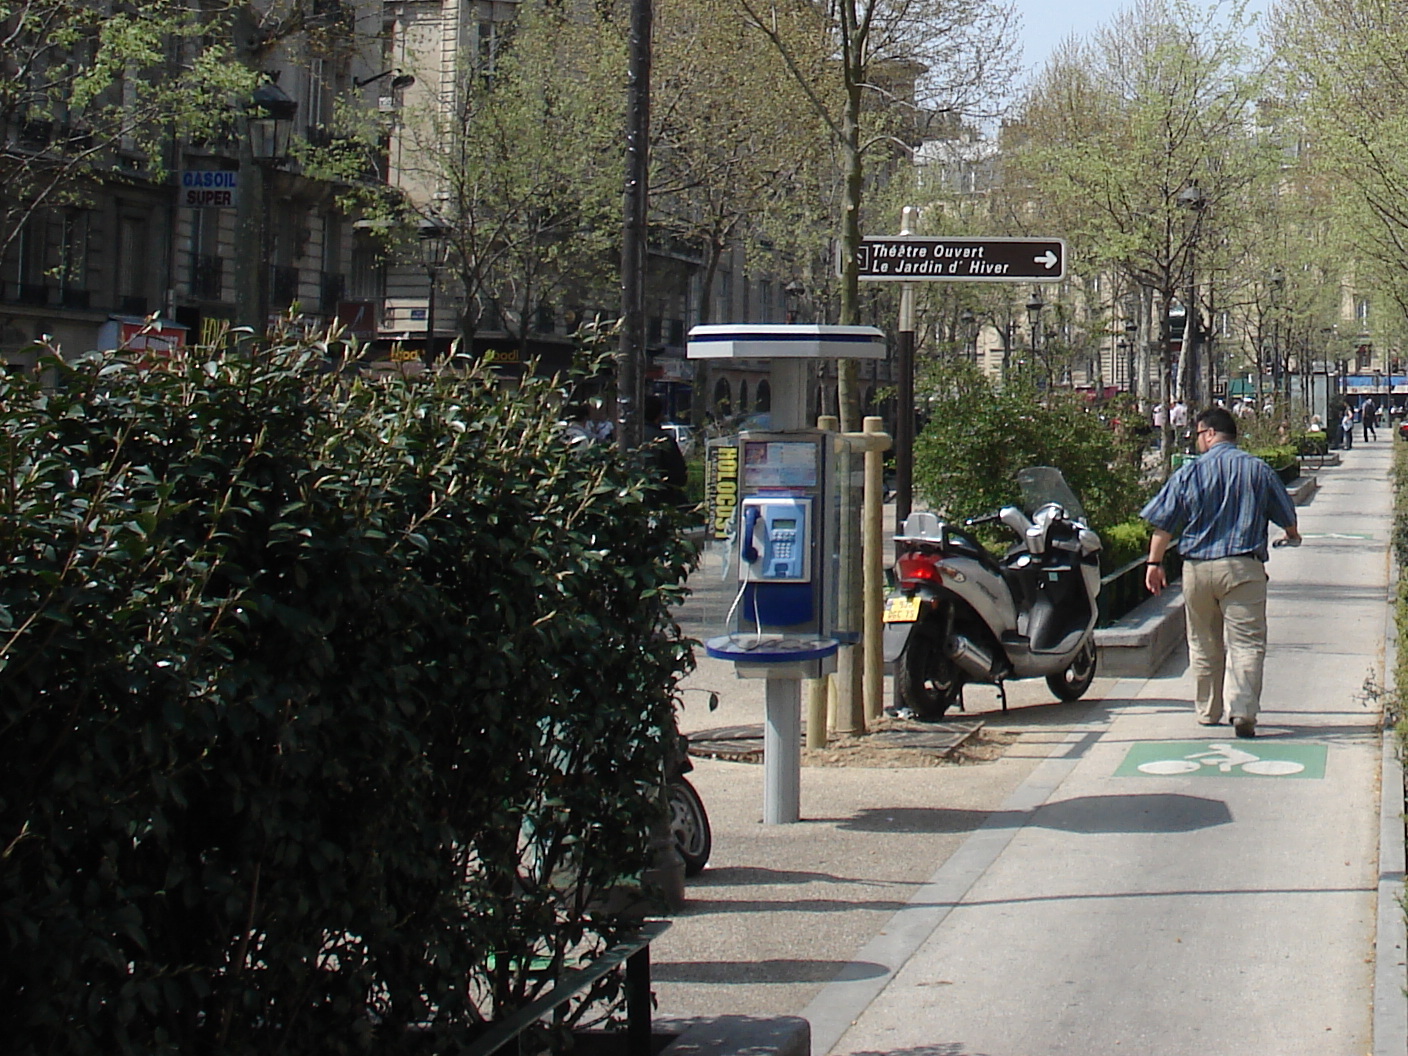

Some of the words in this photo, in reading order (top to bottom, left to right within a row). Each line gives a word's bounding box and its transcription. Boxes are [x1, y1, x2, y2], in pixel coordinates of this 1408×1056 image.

[183, 172, 237, 187] GASOIL
[186, 190, 232, 205] SUPER
[872, 244, 928, 258] Théâtre
[933, 245, 984, 258] Ouvert
[872, 260, 889, 273] Le
[895, 260, 943, 274] Jardin
[969, 260, 1010, 274] Hiver
